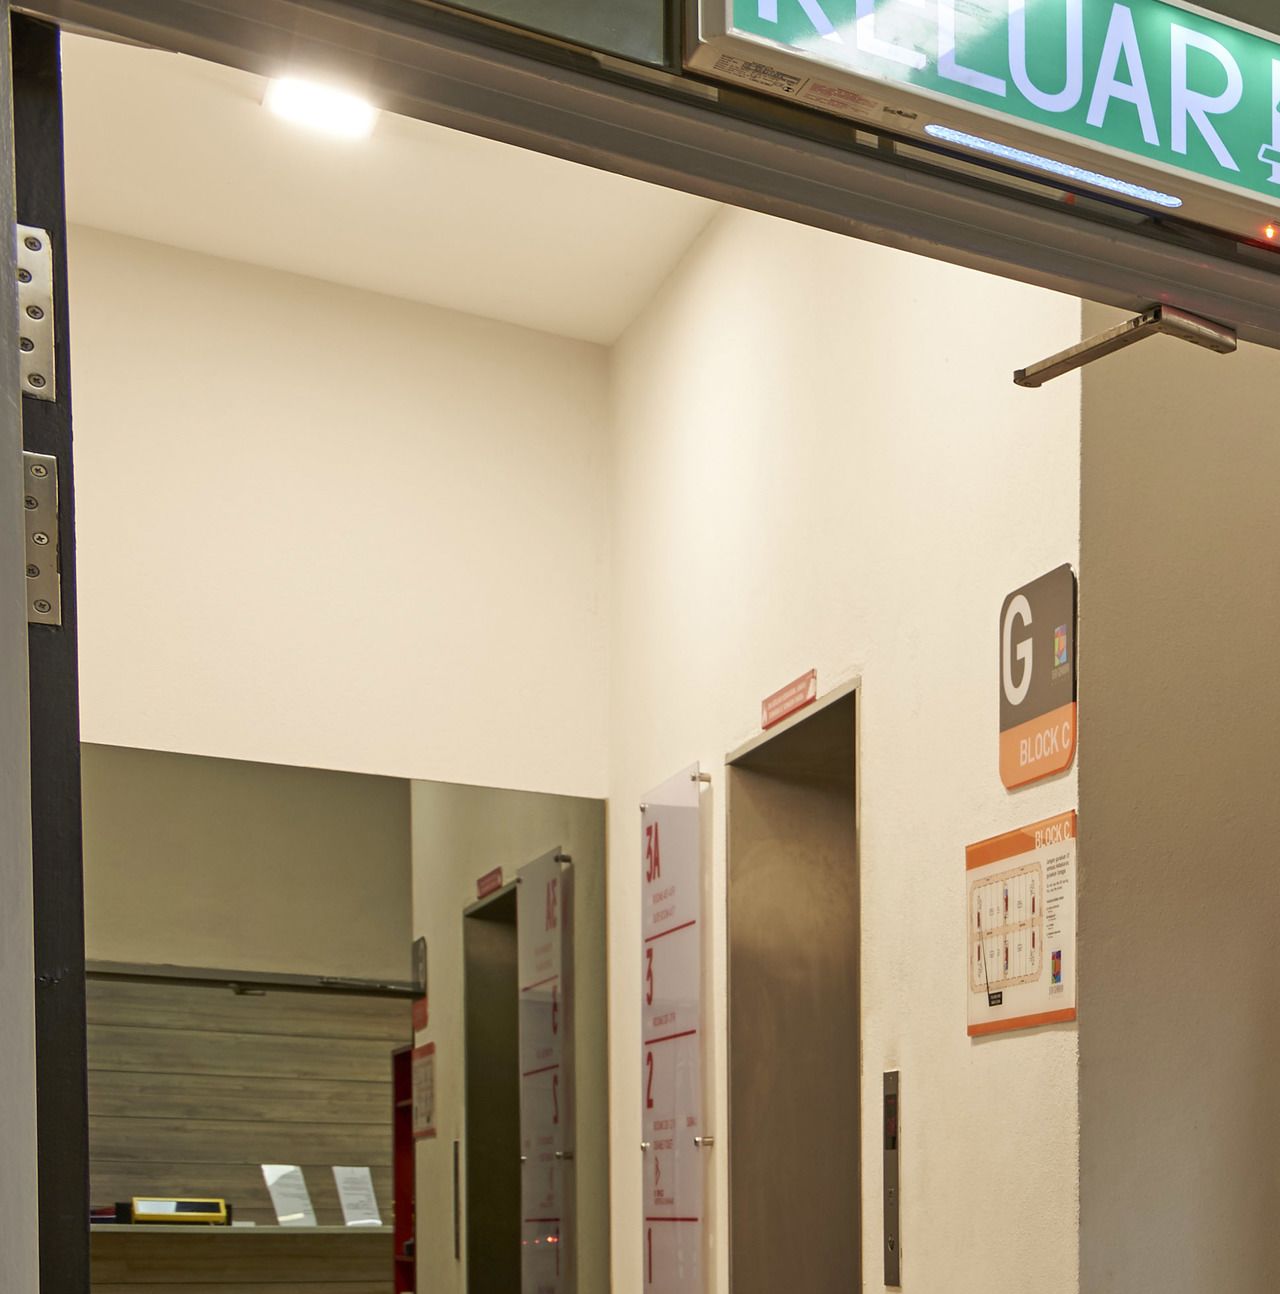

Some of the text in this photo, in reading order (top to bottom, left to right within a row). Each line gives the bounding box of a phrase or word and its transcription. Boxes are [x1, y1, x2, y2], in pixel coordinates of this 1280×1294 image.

[757, 0, 1240, 172] LUAR
[1003, 594, 1033, 706] G
[1020, 721, 1071, 767] BLOCK C
[646, 821, 660, 883] 3A
[1035, 821, 1070, 849] BLOCK C
[646, 947, 653, 1006] 3
[646, 1051, 654, 1109] 2
[648, 1227, 652, 1284] 1
